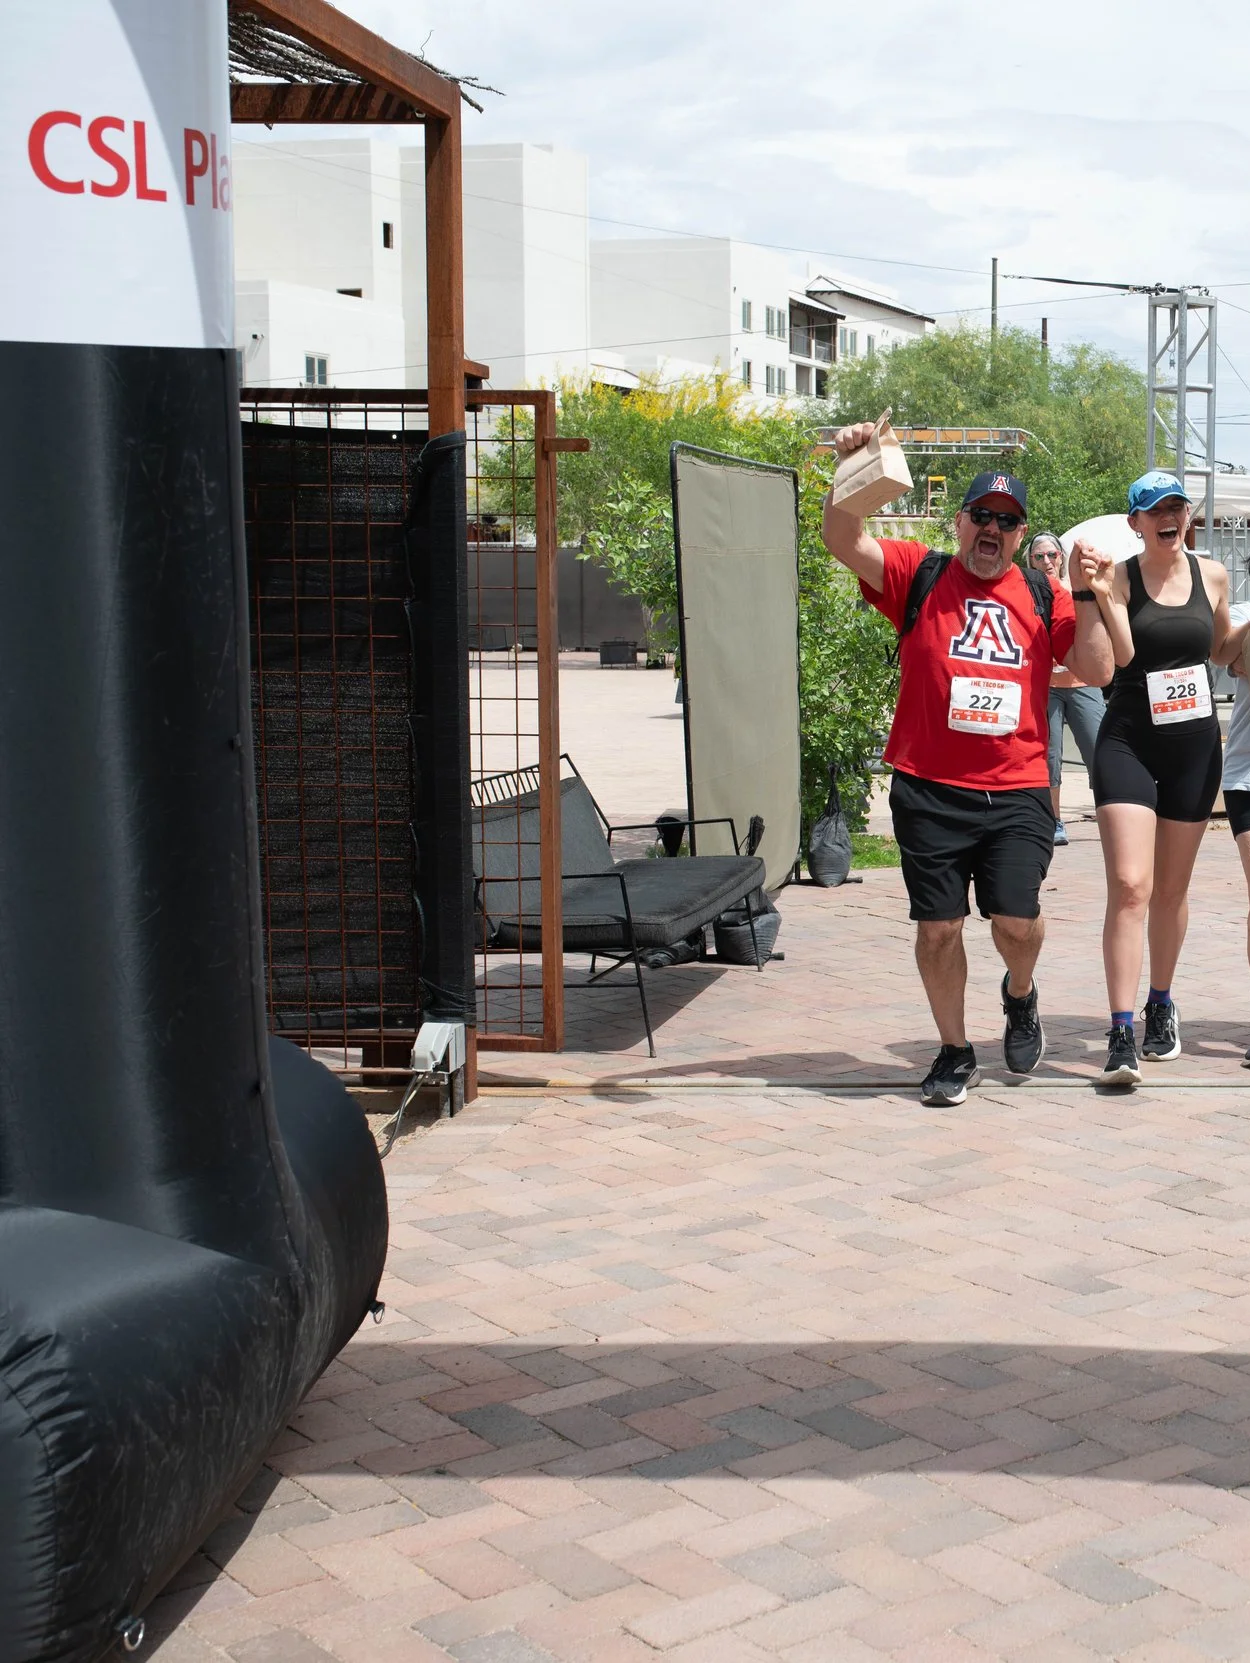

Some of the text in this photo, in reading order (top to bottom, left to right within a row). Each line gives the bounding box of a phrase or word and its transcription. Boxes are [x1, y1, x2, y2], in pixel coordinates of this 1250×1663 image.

[28, 110, 231, 212] CSL Pla
[948, 598, 1023, 669] A
[968, 694, 1003, 711] 227
[1166, 682, 1197, 700] 228
